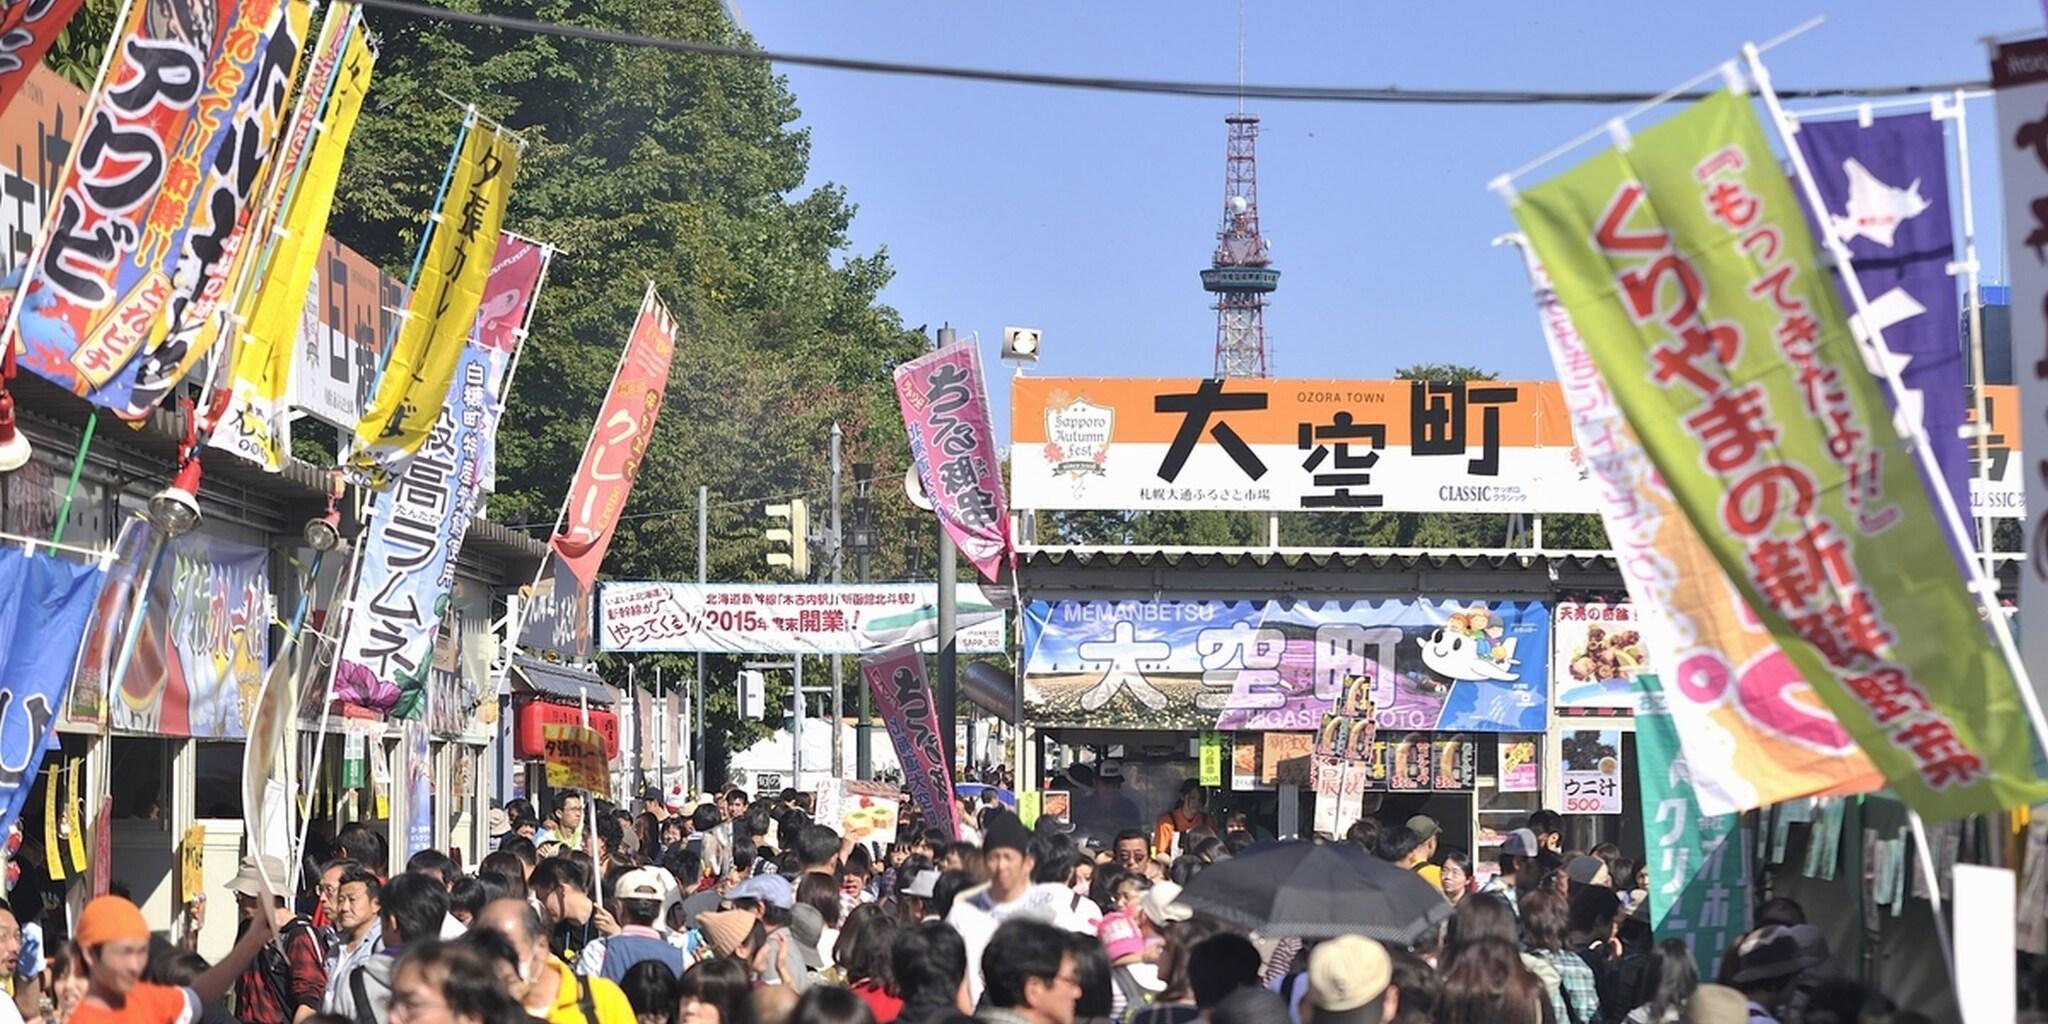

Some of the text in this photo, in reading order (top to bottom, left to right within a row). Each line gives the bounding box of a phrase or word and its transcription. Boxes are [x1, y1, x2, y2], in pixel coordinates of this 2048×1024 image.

[42, 33, 201, 308] アワビ
[1297, 391, 1385, 404] OZORA TOWN
[1054, 415, 1106, 429] Sapporo
[1055, 429, 1105, 443] Autumn
[1154, 379, 1519, 508] 大空町
[1140, 488, 1271, 502] 札幌大通ふるさと市場
[1439, 485, 1492, 502] CLASSIC
[1064, 604, 1214, 623] MEMANBETSU
[1078, 620, 1404, 712] 大空町
[1564, 778, 1617, 797] ウニ汁
[1567, 798, 1601, 811] 500
